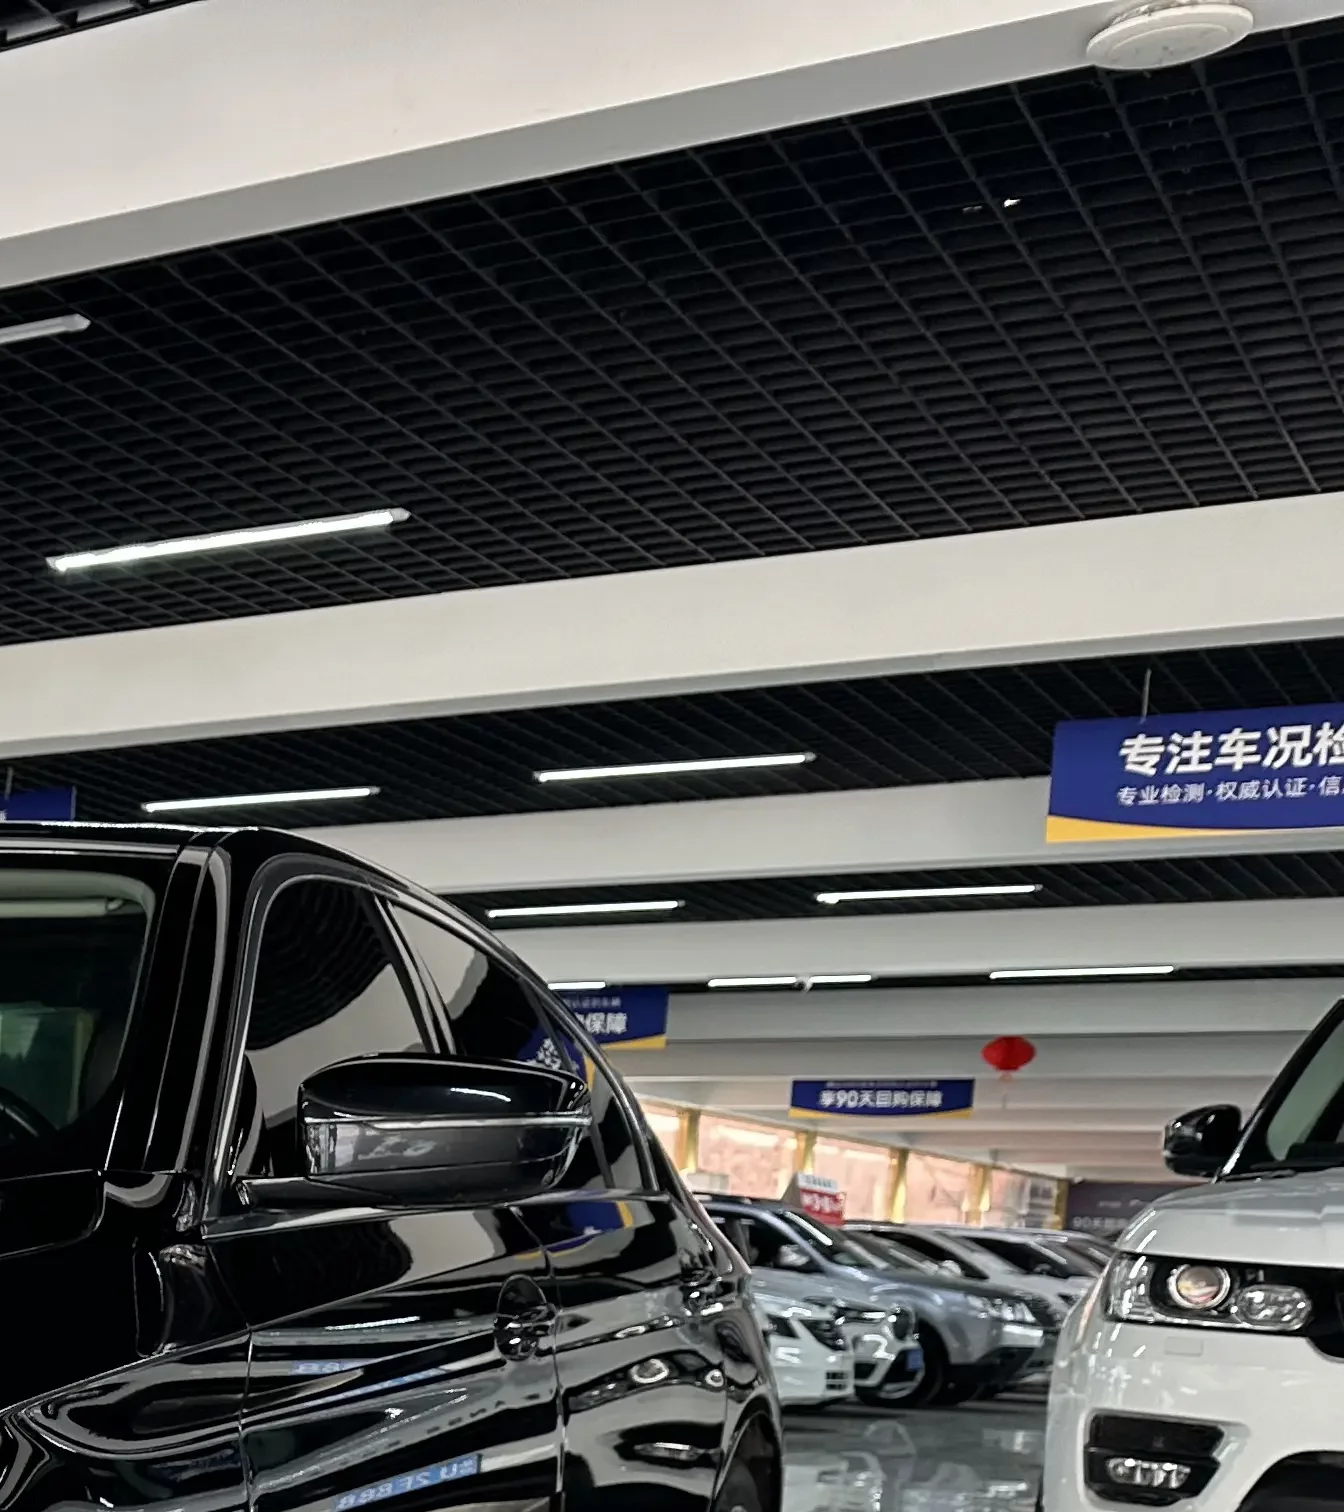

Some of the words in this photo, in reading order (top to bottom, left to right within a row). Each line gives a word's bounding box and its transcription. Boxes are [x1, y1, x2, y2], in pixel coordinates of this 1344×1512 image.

[1116, 775, 1344, 807] 专业检测·权威认证·信
